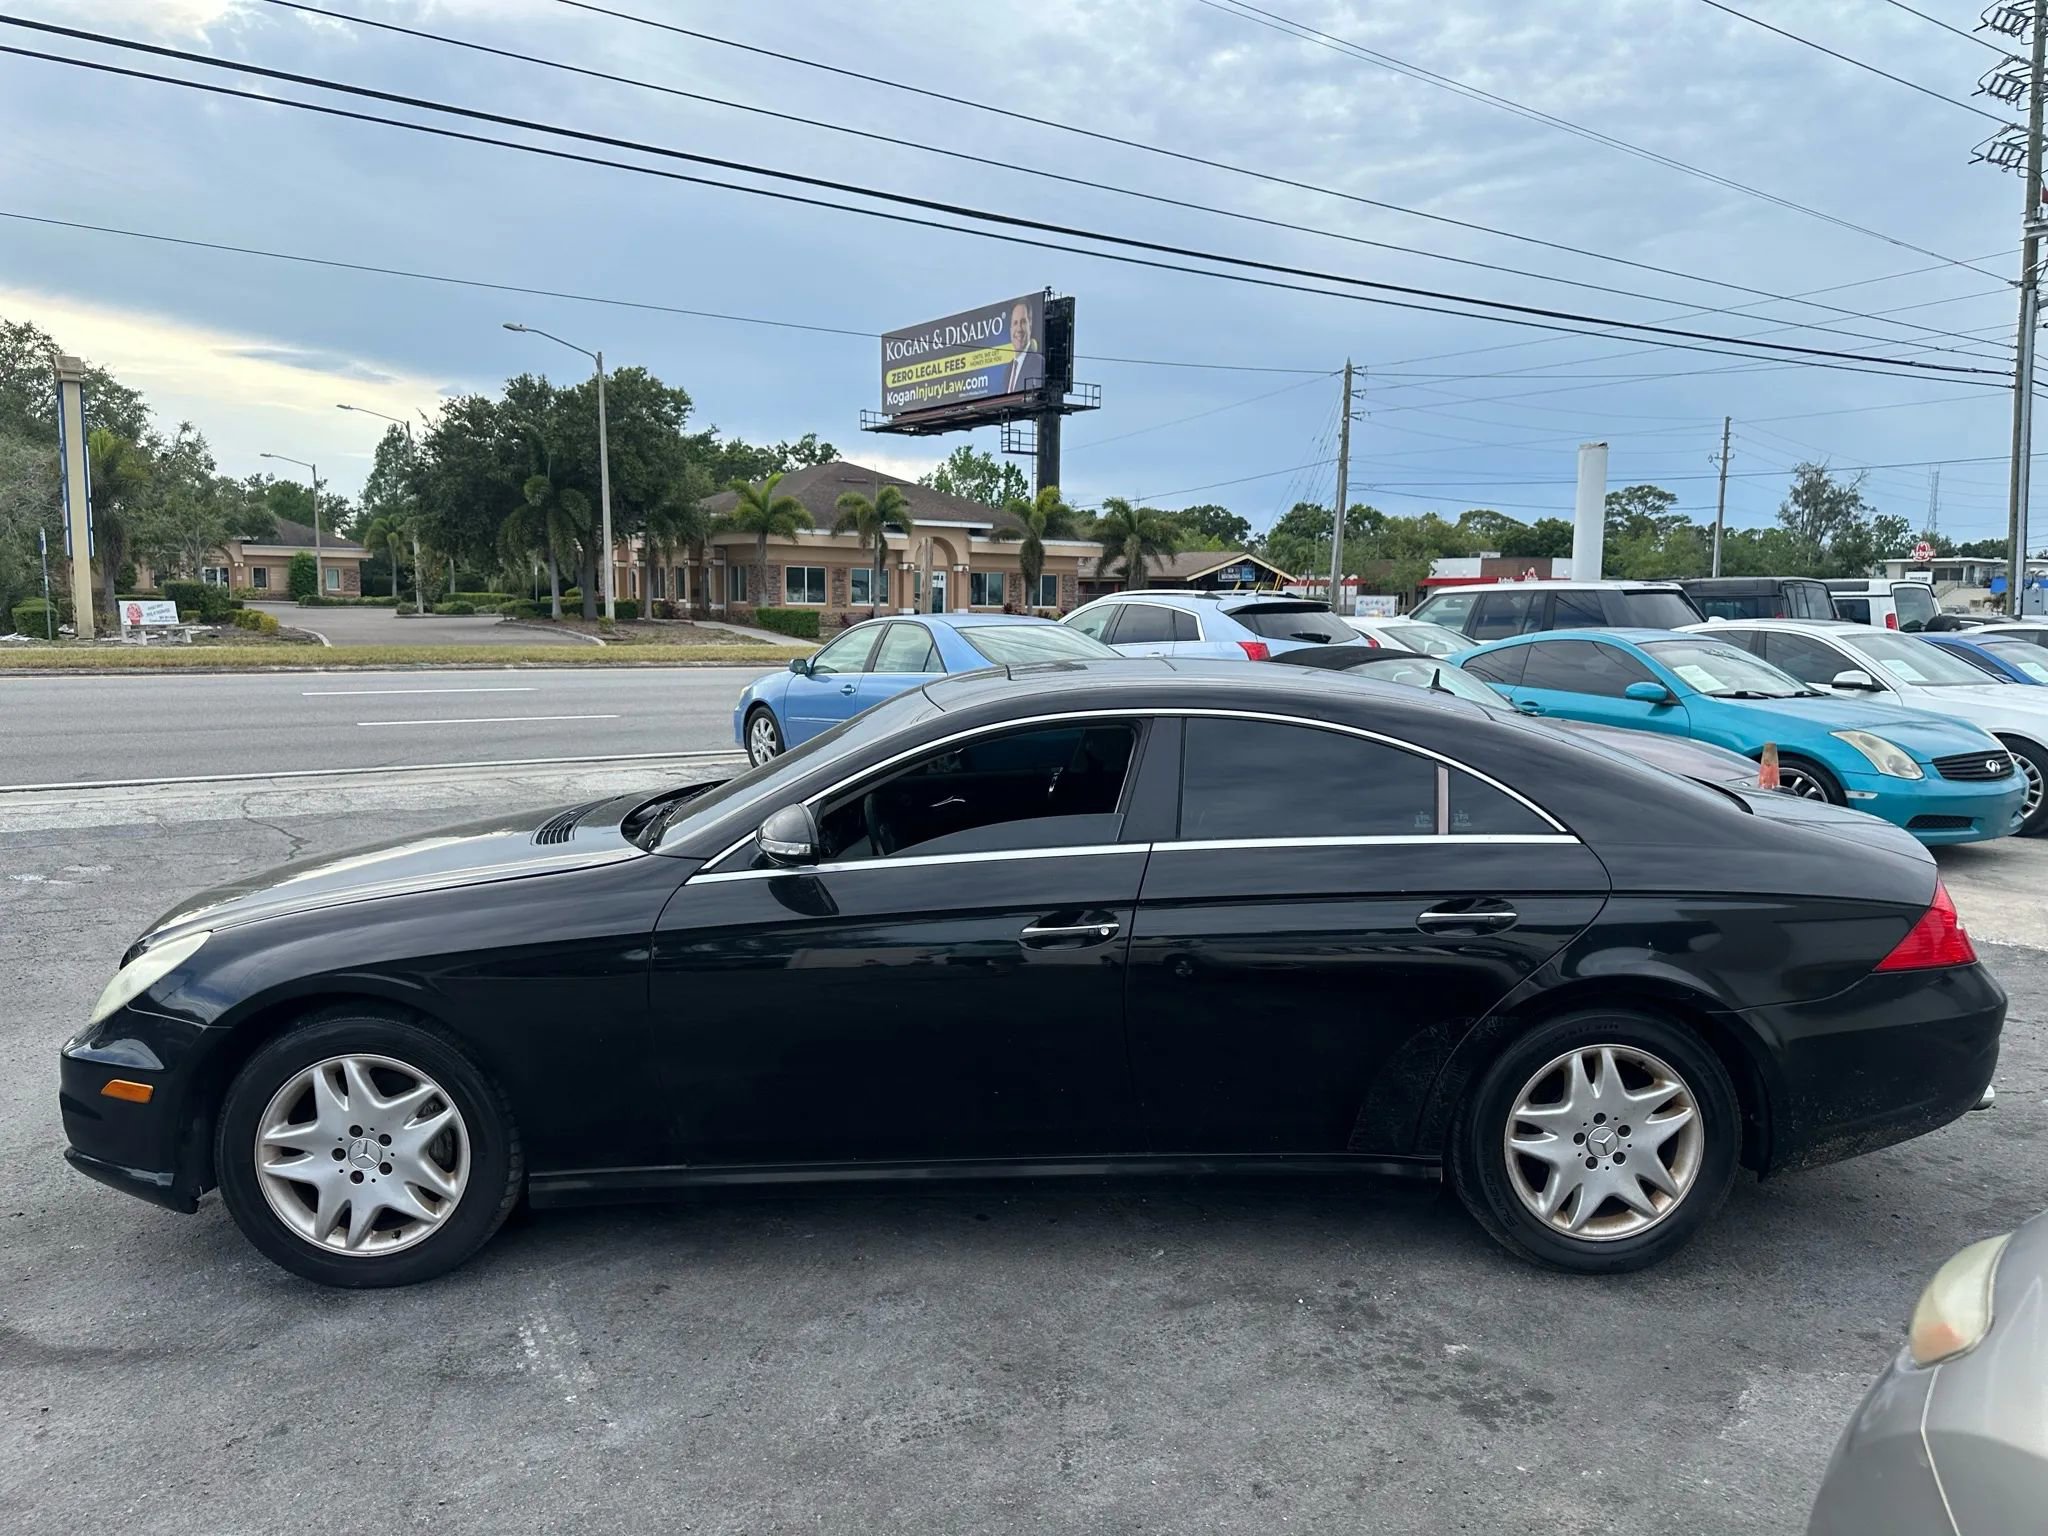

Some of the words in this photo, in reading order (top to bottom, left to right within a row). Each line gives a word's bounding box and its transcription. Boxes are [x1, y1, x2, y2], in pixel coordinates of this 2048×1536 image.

[932, 329, 943, 350] &
[891, 369, 914, 385] ZERO
[915, 362, 943, 378] LEGAL
[944, 357, 966, 373] FEES
[886, 375, 989, 406] KoganInjuryLaw.com
